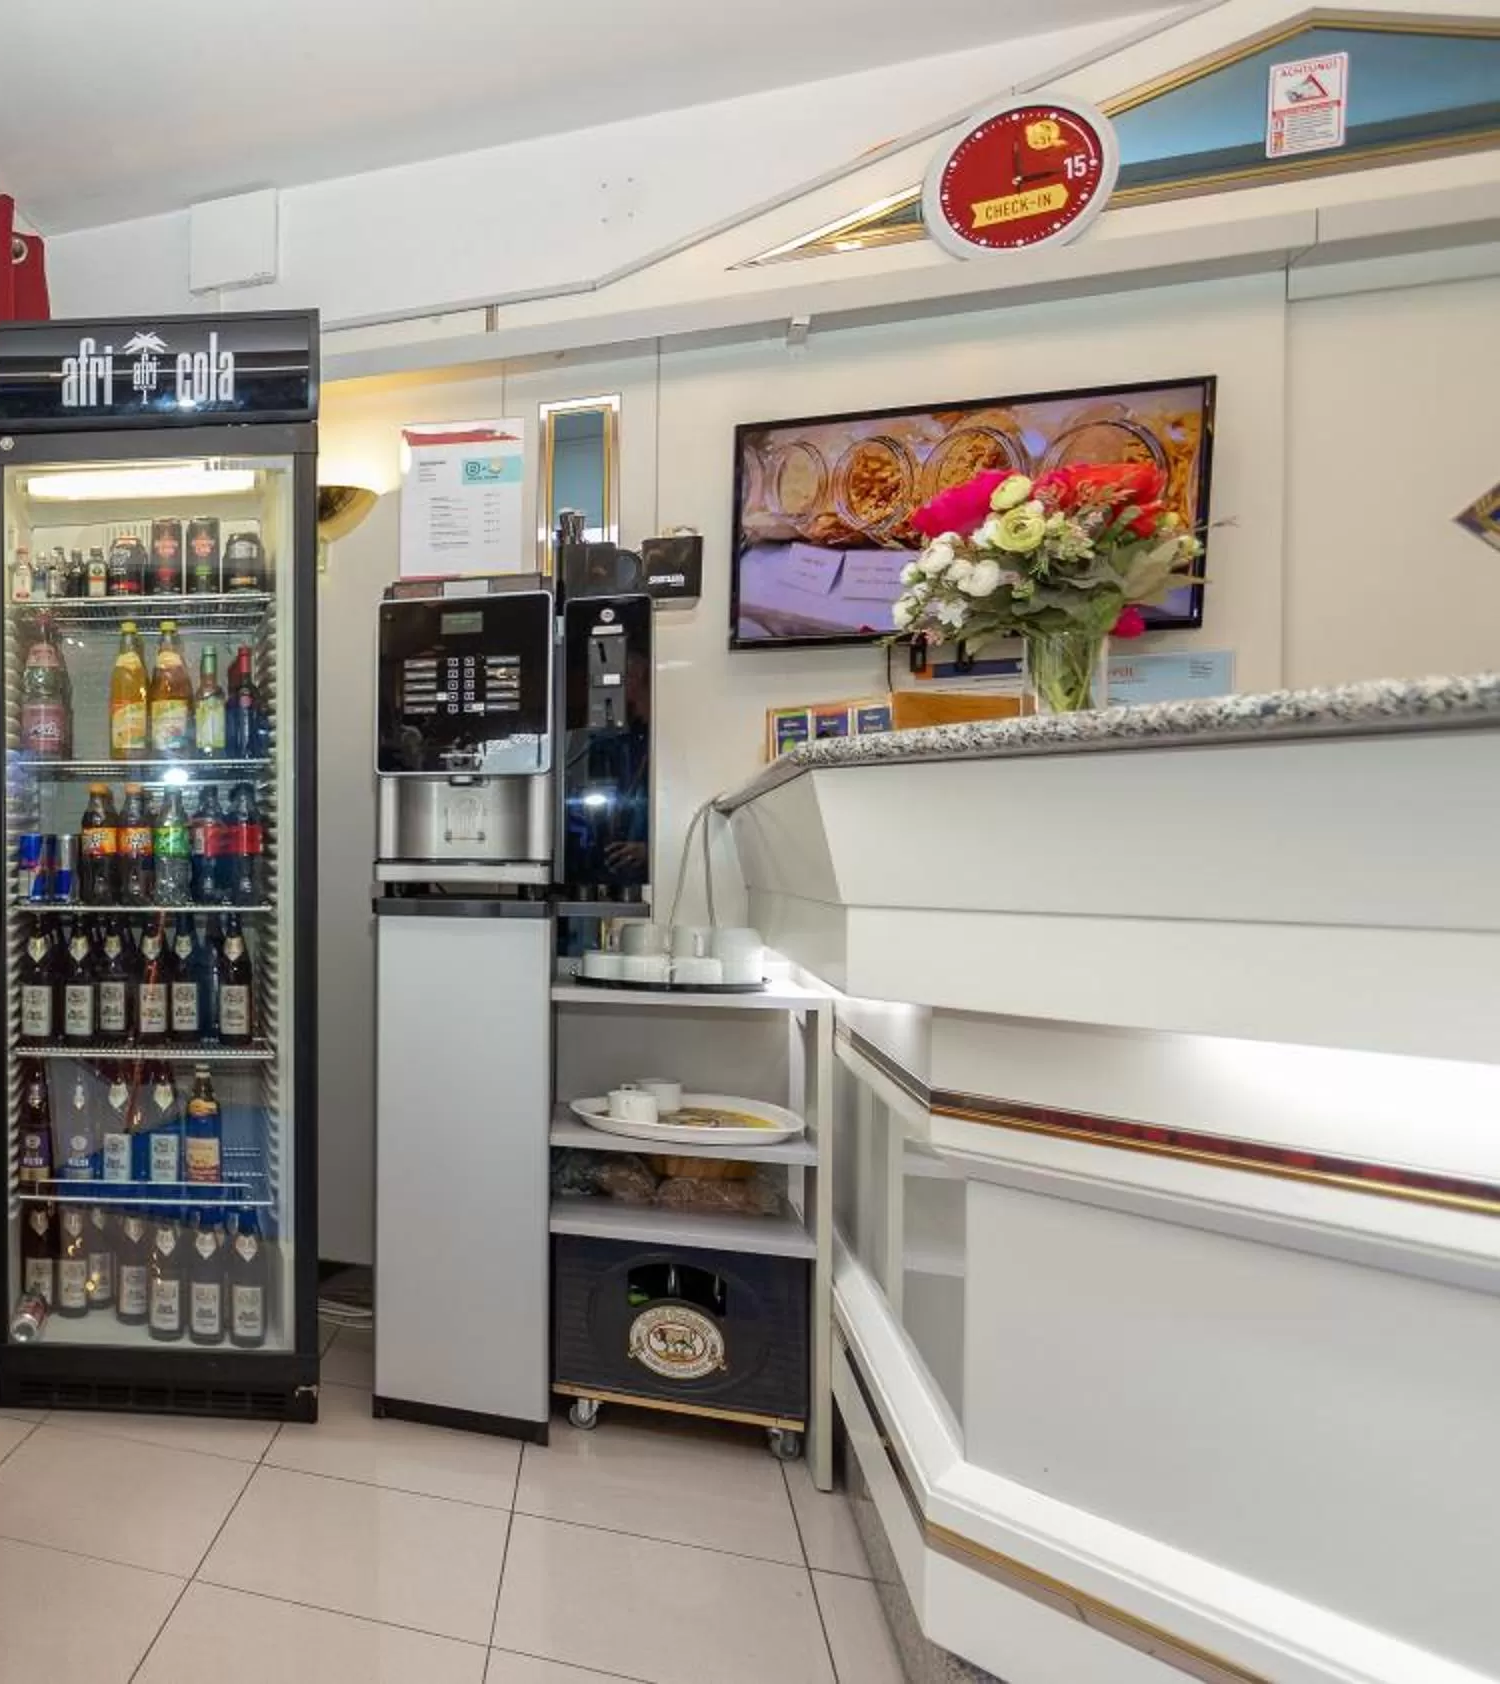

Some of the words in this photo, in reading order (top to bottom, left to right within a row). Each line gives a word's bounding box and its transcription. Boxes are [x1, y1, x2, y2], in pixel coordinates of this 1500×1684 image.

[1063, 154, 1087, 179] 15
[985, 192, 1052, 221] CHECK-IN
[61, 337, 113, 407] afri
[176, 331, 235, 405] cola
[133, 354, 157, 385] afri
